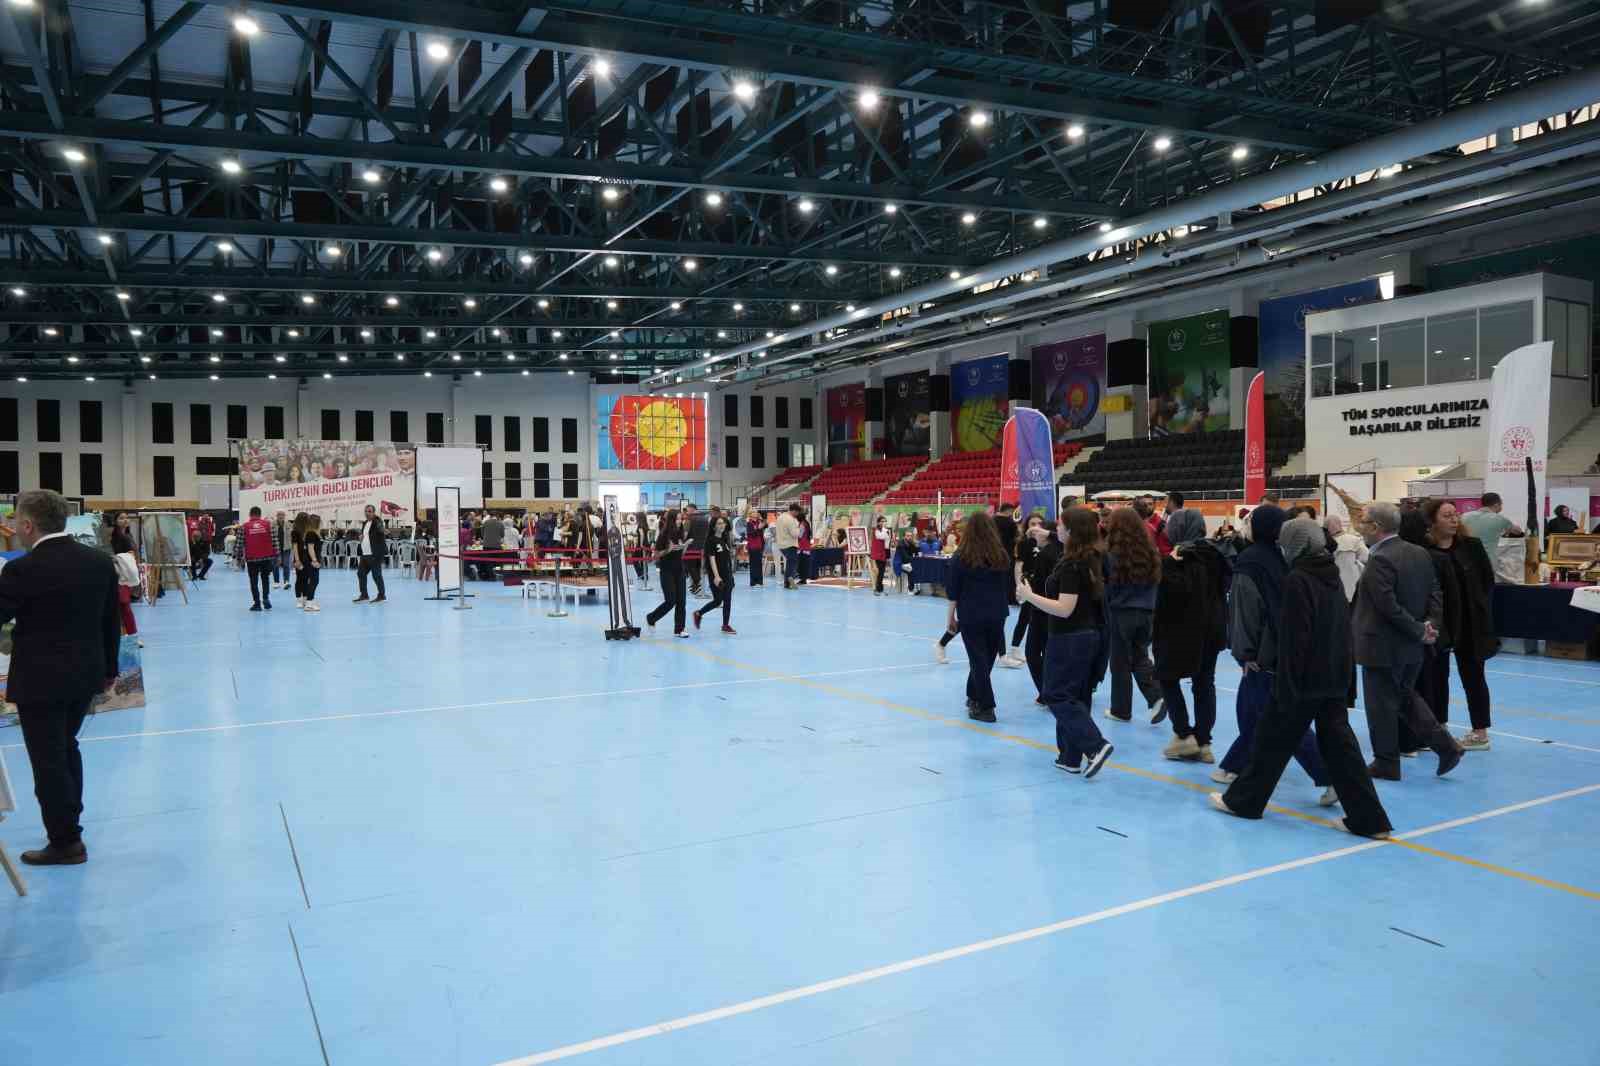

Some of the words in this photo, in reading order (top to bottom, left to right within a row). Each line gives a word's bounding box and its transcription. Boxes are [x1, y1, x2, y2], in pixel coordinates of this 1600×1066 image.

[1341, 408, 1367, 421] TÜM
[1371, 398, 1489, 419] SPORCULARIMIZA
[1349, 420, 1422, 436] BAŞARILAR
[1427, 414, 1481, 430] DİLERİZ
